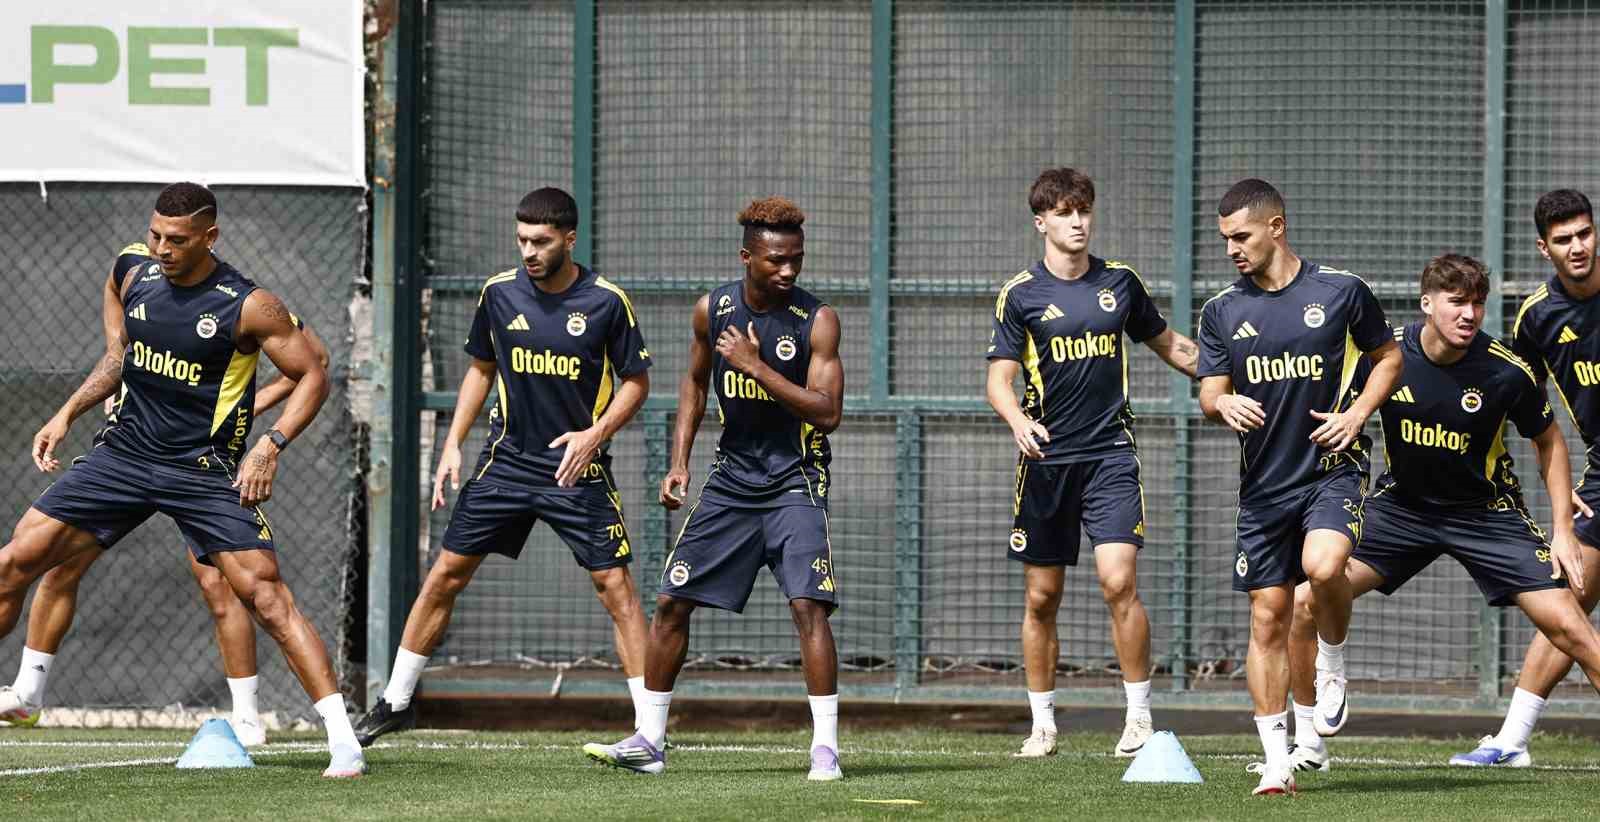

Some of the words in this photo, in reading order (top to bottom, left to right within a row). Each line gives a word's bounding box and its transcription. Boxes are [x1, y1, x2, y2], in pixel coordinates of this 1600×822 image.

[0, 25, 299, 106] PET
[1051, 331, 1116, 362] Otokoç
[133, 340, 202, 386] Otokoç
[511, 346, 581, 380] Otokoç
[1246, 351, 1324, 384] Otokoç
[1400, 418, 1471, 455] Otokoç
[198, 456, 210, 470] 3
[1320, 452, 1342, 472] 22
[607, 523, 623, 540] 70
[811, 557, 828, 574] 45
